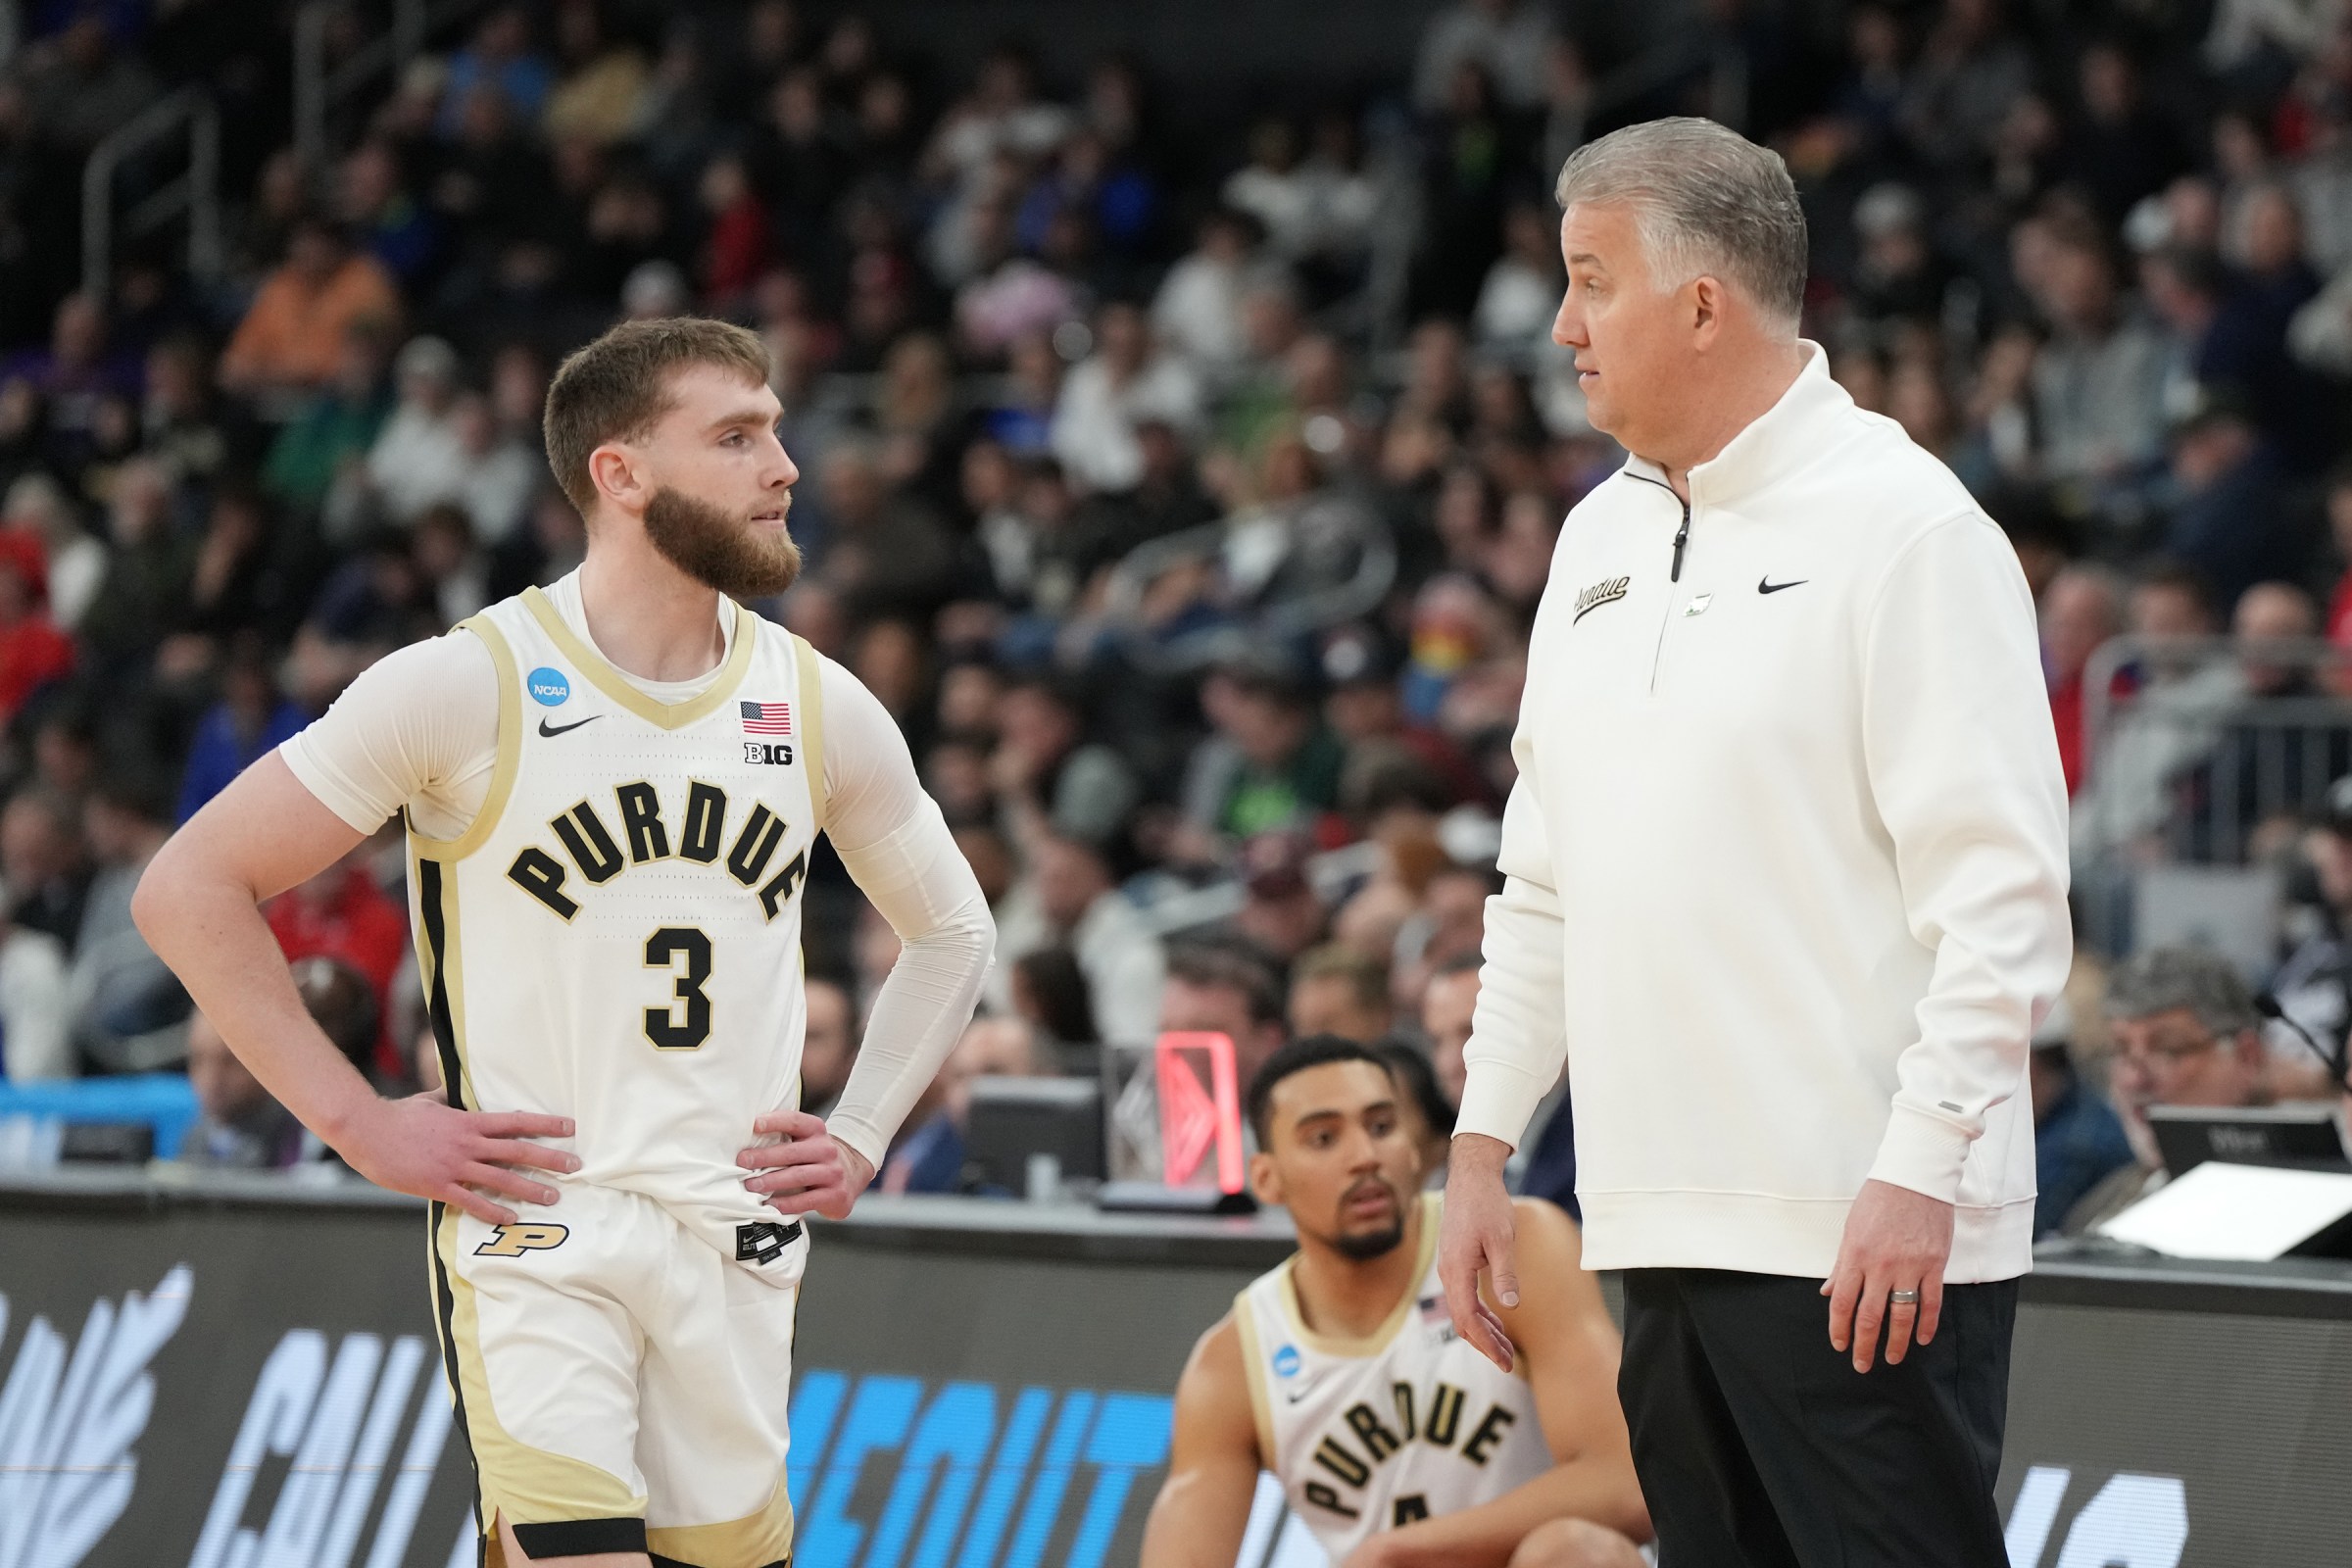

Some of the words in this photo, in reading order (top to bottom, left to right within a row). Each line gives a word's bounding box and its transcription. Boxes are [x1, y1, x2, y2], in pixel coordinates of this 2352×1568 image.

[534, 684, 567, 697] NCAA
[504, 778, 806, 925] PURDUE
[642, 924, 713, 1052] 3
[472, 1223, 569, 1257] P
